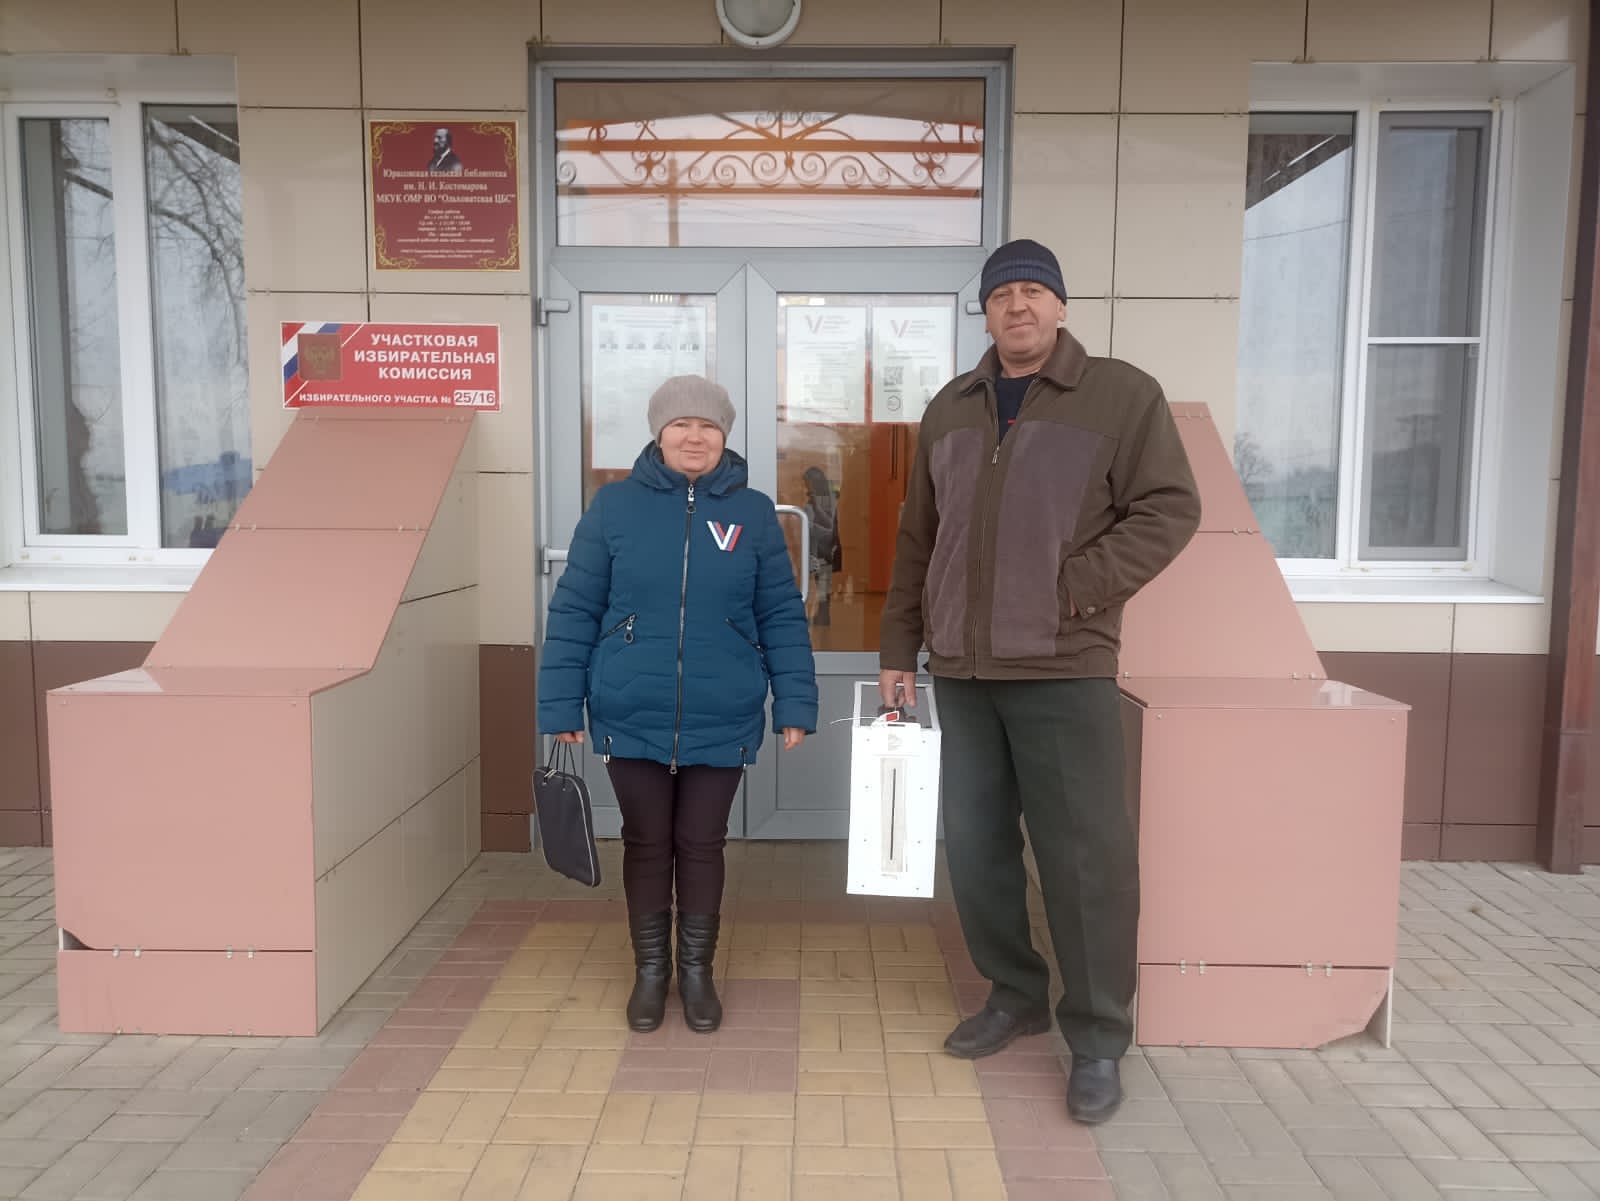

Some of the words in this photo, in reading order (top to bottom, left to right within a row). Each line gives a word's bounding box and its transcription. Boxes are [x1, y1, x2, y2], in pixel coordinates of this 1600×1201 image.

[371, 334, 478, 348] УЧАСТКОВАЯ
[354, 350, 496, 364] ИЗБИРАТЕЛЬНАЯ
[379, 367, 472, 380] КОМИССИЯ
[299, 393, 391, 402] ИЗБИРАТЕЛЬНОГО
[394, 394, 438, 404] УЧАСТКА
[441, 396, 451, 404] №
[453, 391, 496, 405] 25/16
